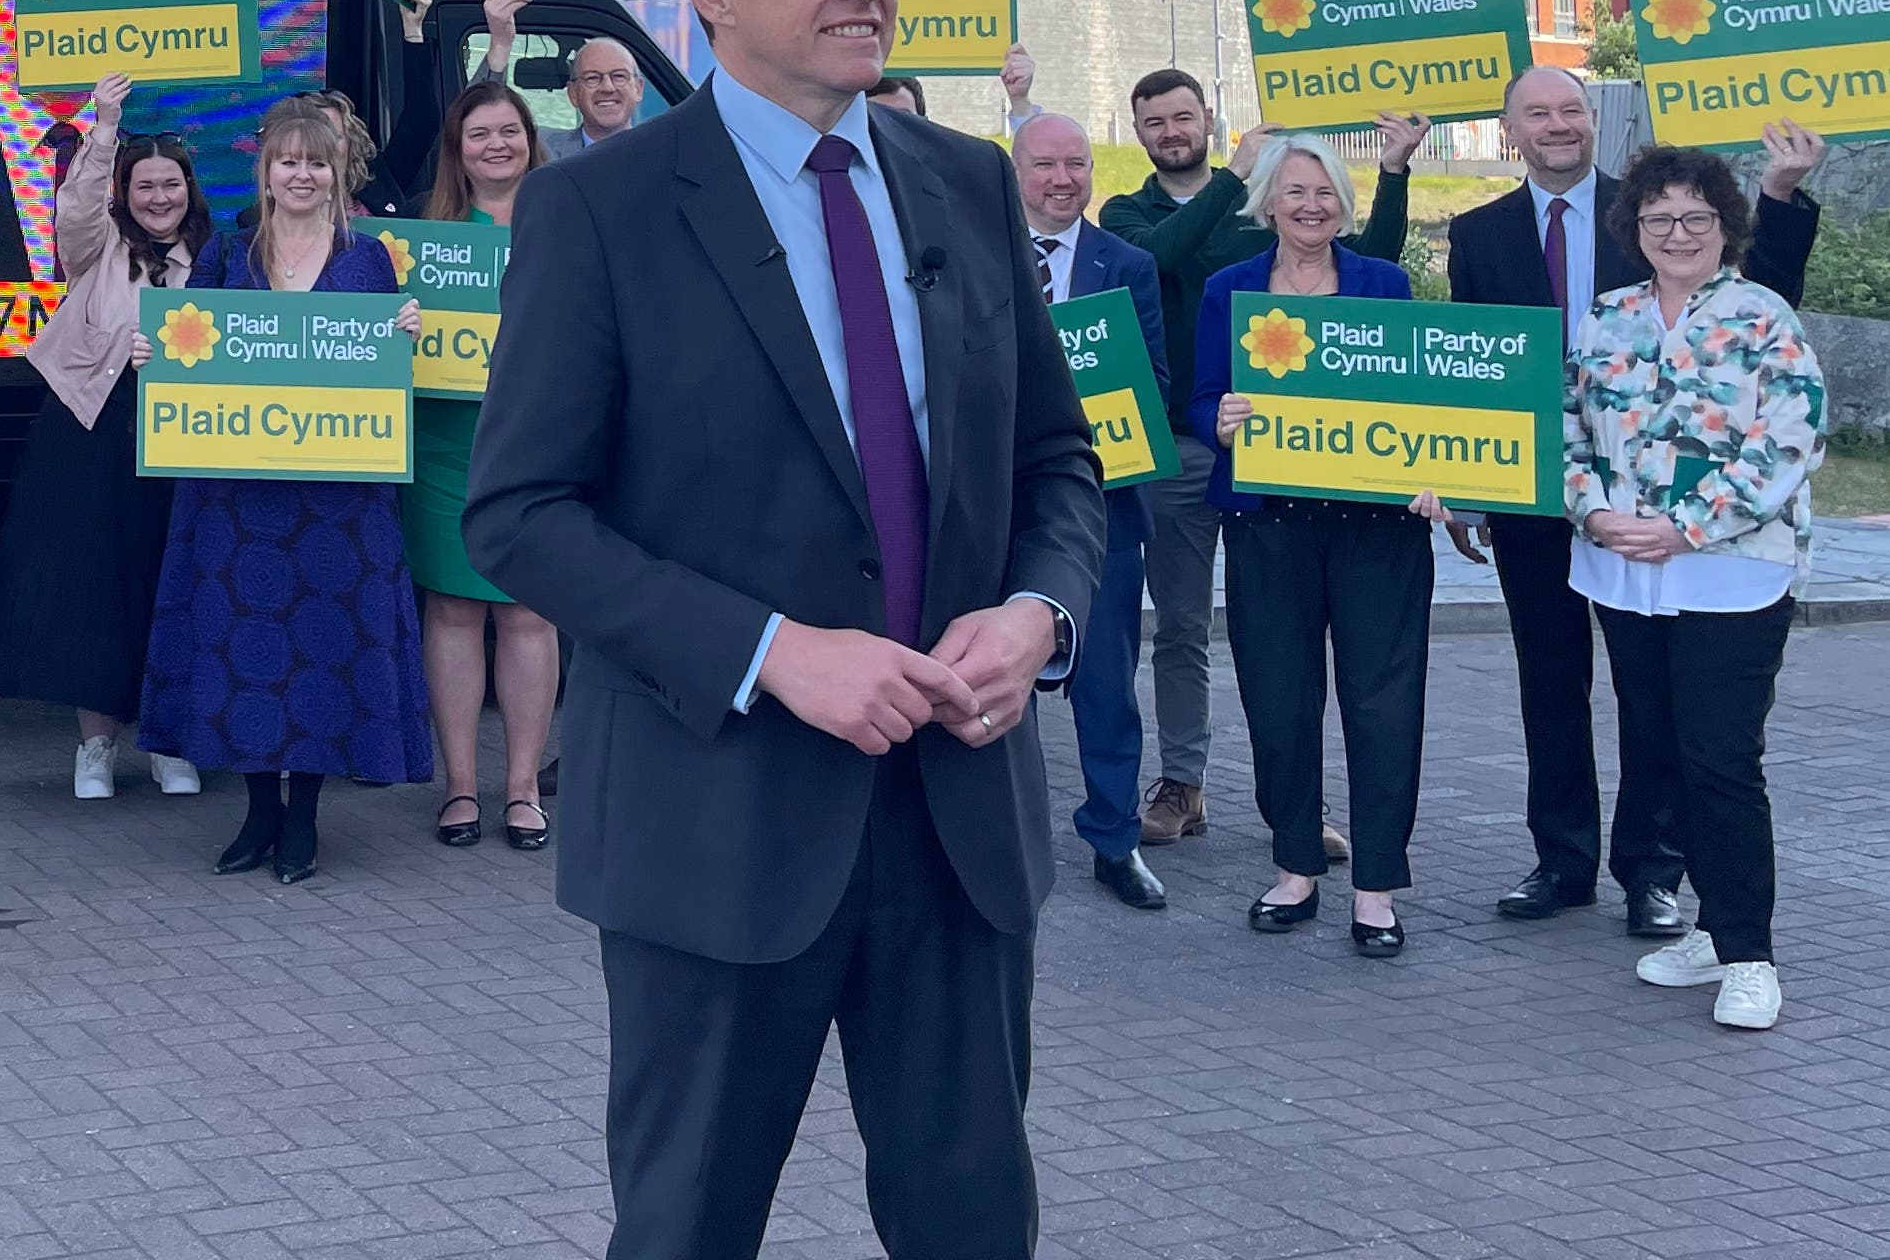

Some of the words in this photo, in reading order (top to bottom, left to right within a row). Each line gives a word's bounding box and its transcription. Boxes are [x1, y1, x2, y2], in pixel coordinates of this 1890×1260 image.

[1322, 1, 1396, 26] Cymru
[1723, 3, 1811, 31] Cymru
[24, 26, 107, 58] Plaid
[115, 24, 228, 59] Cymru
[898, 15, 997, 46] ymru
[1265, 63, 1360, 101] Plaid
[1369, 56, 1499, 95] Cymru
[1656, 73, 1770, 115] Plaid
[1780, 67, 1890, 109] Cym
[421, 242, 472, 264] Plaid
[420, 264, 489, 289] Cymru
[226, 313, 279, 335] Plaid
[312, 315, 370, 342] Party
[372, 317, 396, 338] of
[1085, 318, 1109, 342] of
[1321, 322, 1384, 347] Plaid
[225, 336, 298, 363] Cymru
[311, 340, 378, 362] Wales
[1424, 327, 1496, 358] Party
[1500, 333, 1527, 356] of
[1320, 347, 1407, 376] Cymru
[1424, 354, 1505, 381] Wales
[153, 401, 250, 436] Plaid
[261, 403, 392, 445] Cymru
[1244, 414, 1354, 455] Plaid
[1365, 421, 1520, 467] Cymru
